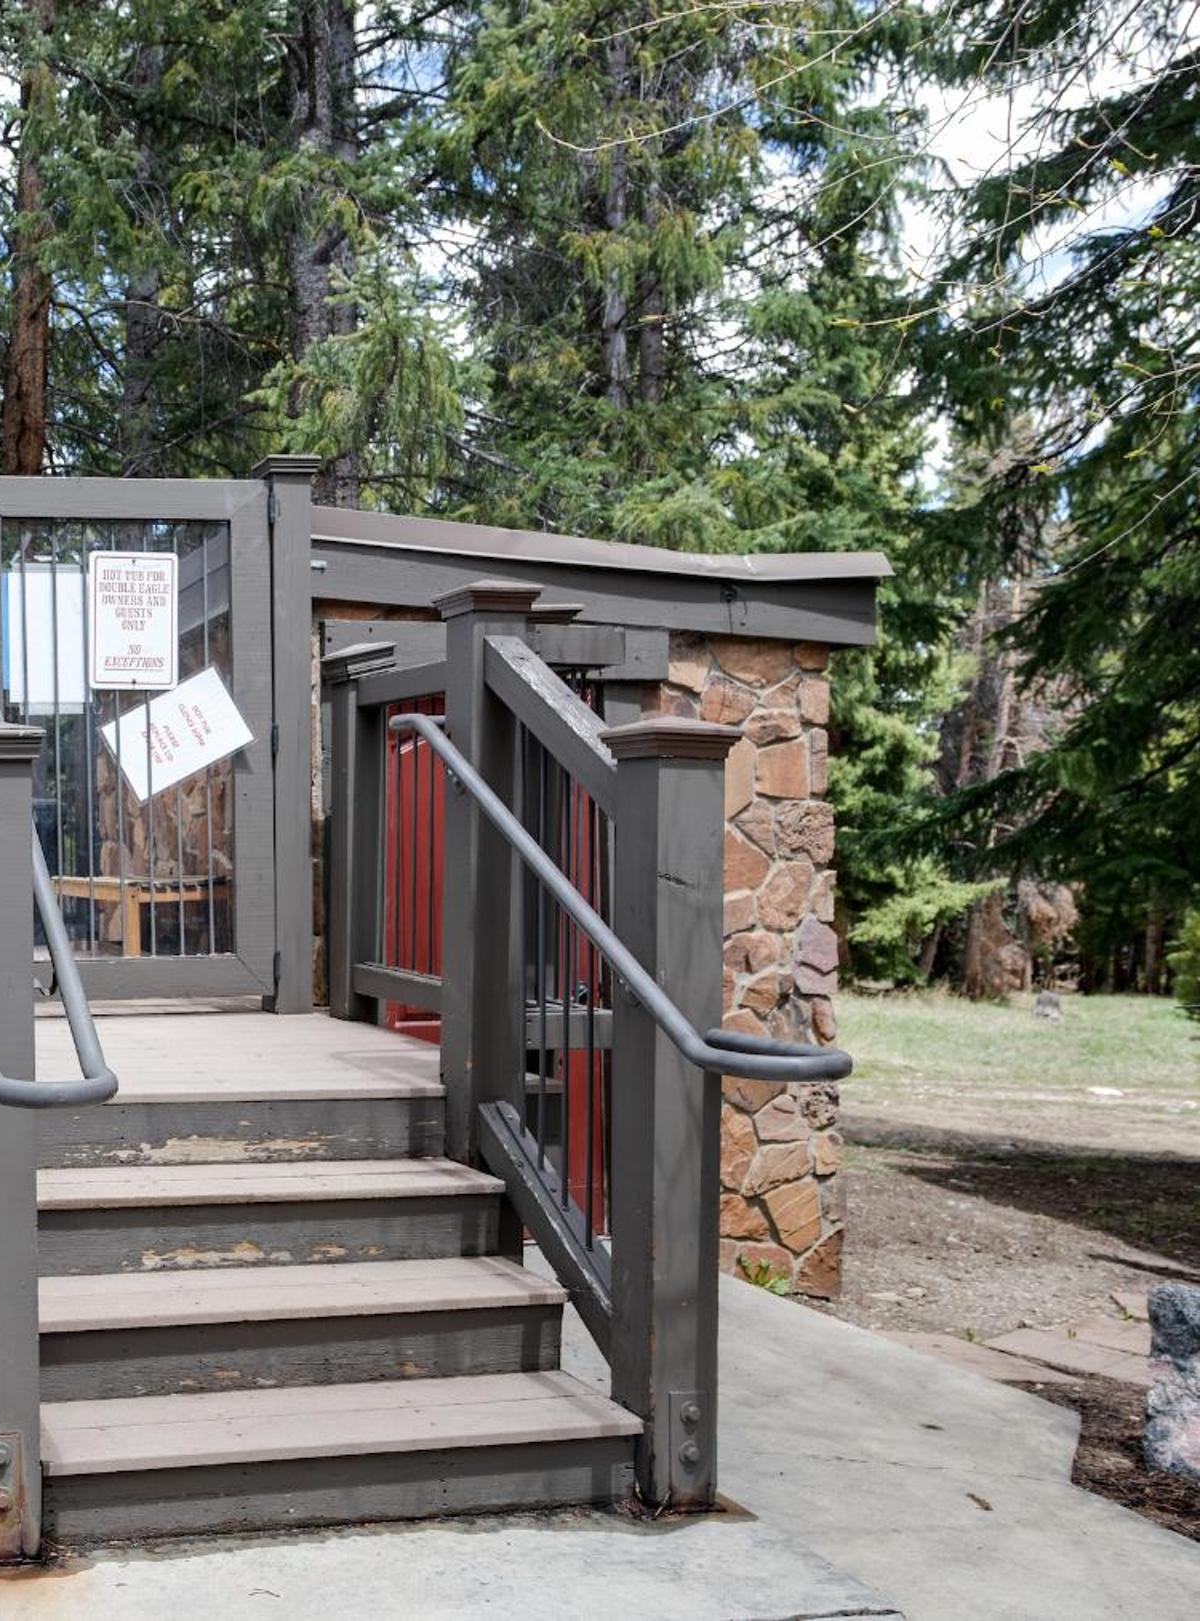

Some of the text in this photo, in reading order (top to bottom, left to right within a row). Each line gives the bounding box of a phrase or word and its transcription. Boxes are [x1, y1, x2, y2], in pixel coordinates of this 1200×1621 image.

[103, 569, 166, 582] HOT TUB FOR
[99, 582, 171, 594] DOUBLE EAGLE
[102, 594, 167, 607] OWNERS AND
[115, 607, 153, 618] GUESTS
[121, 619, 146, 631] ONLY
[128, 643, 143, 655] NO
[104, 655, 166, 668] EXCEPTIONS
